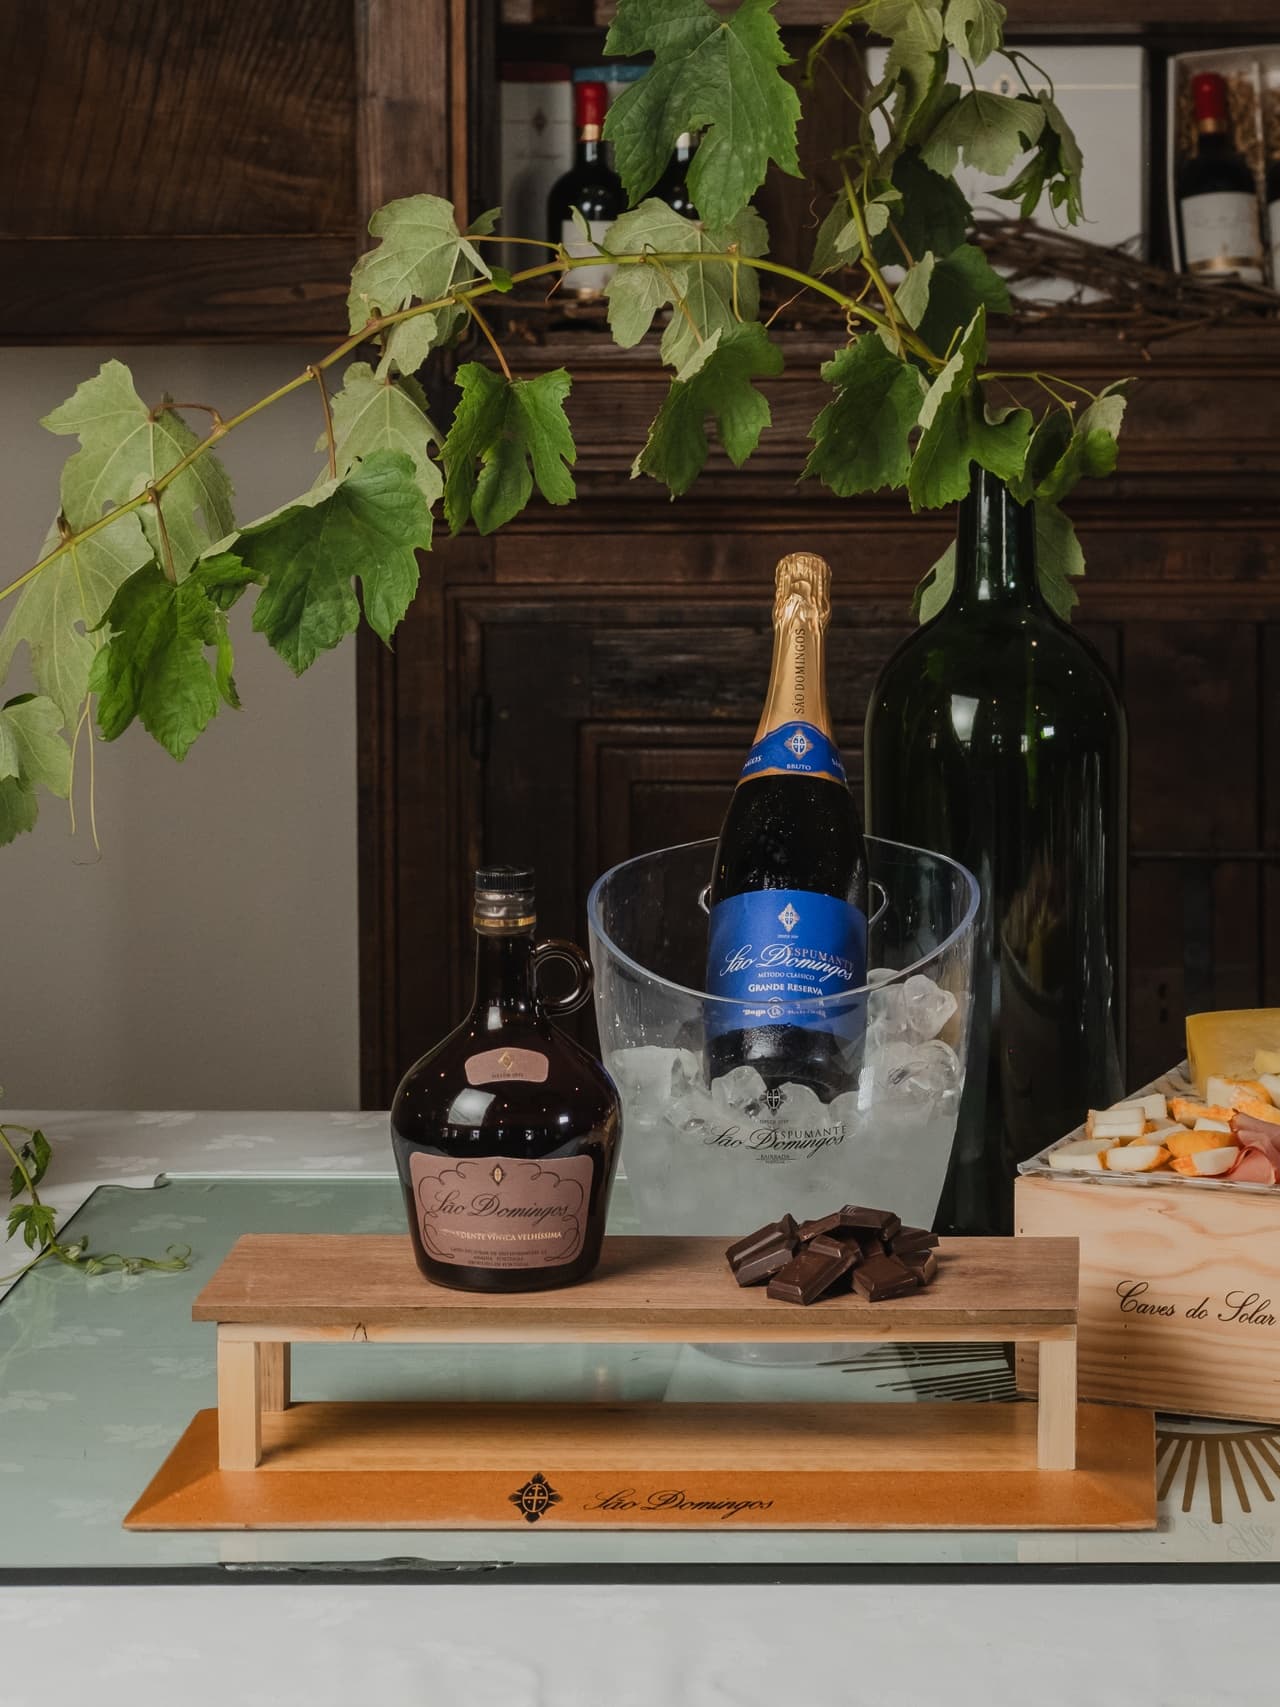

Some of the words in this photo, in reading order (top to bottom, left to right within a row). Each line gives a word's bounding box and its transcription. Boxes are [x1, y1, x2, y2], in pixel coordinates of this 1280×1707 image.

[795, 628, 806, 691] DOMINGOS
[792, 694, 805, 715] SÃO
[786, 763, 812, 771] BRUTO
[720, 944, 756, 976] São
[756, 943, 853, 982] Domingos
[748, 983, 784, 993] GRANDE
[787, 983, 823, 996] RESERVA
[704, 1126, 743, 1147] São
[745, 1127, 845, 1159] Domingos
[431, 1190, 465, 1215] São
[467, 1192, 569, 1227] Domingos
[1116, 1280, 1176, 1317] Caves
[1185, 1297, 1210, 1320] do
[1218, 1290, 1278, 1326] Solar
[583, 1488, 639, 1511] São
[640, 1489, 774, 1520] Domingos
